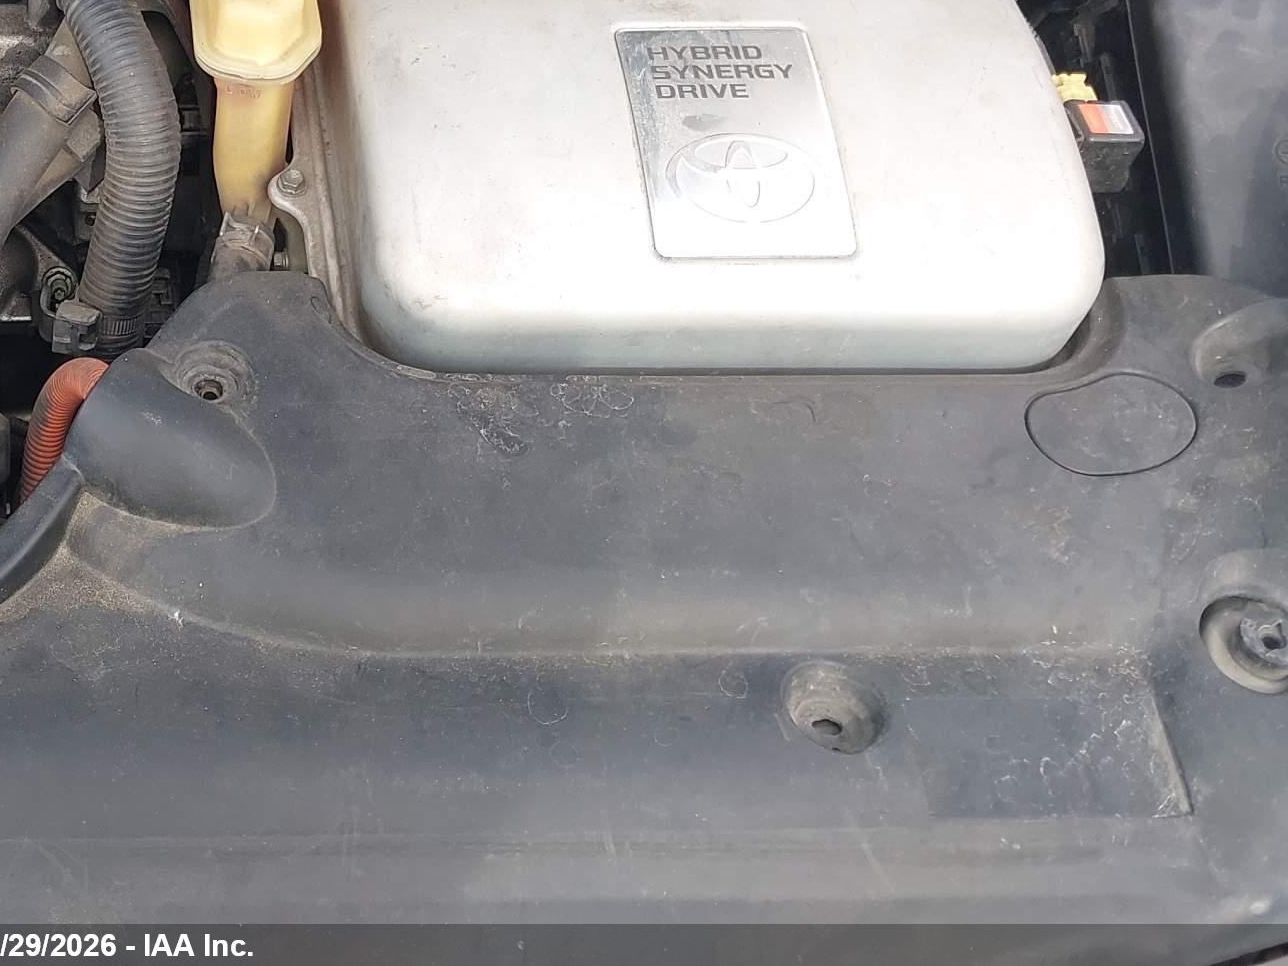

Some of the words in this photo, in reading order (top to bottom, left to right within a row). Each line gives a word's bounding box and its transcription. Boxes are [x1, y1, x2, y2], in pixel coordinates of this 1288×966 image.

[648, 45, 762, 60] HYBRID
[653, 65, 793, 80] SYNERGY
[656, 84, 749, 99] DRIVE
